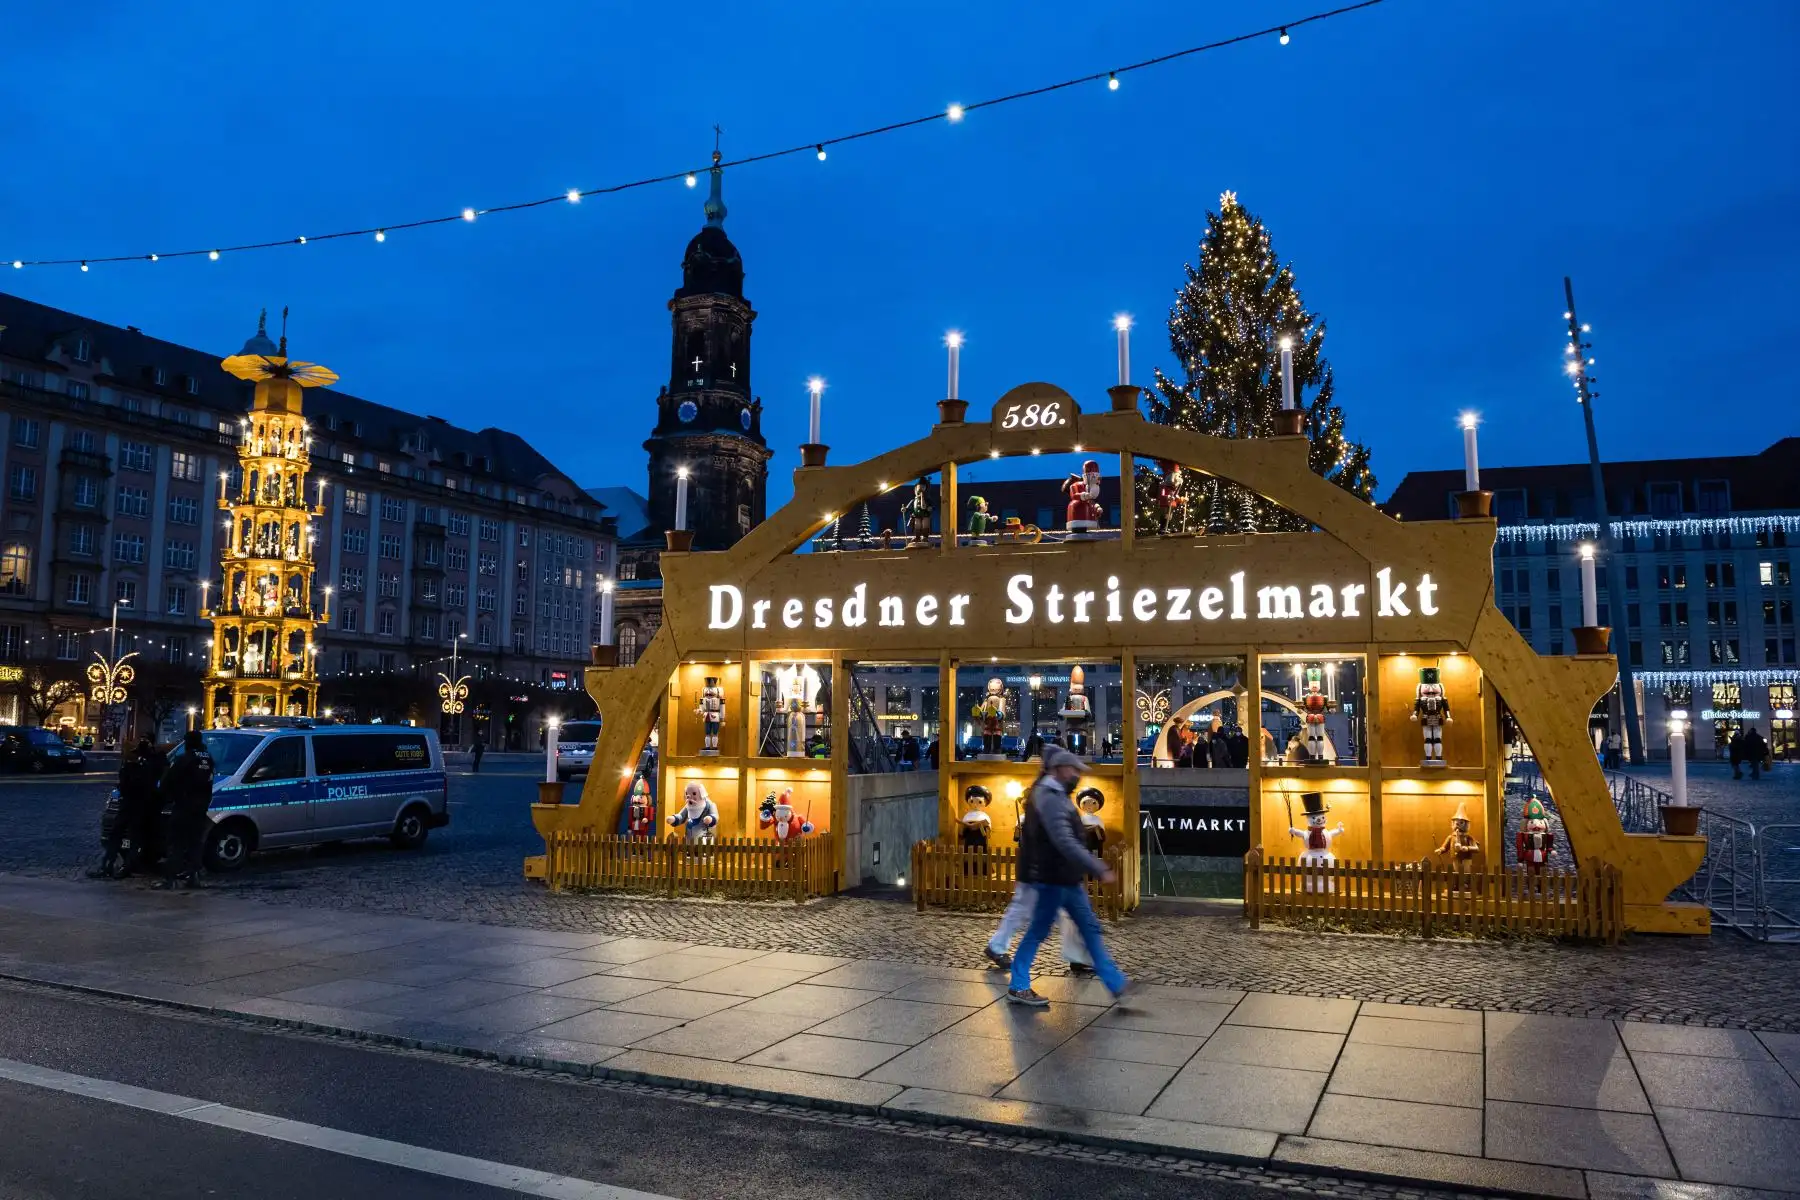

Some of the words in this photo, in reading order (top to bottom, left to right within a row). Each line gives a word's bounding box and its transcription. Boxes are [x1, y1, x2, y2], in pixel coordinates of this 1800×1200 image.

[1001, 402, 1066, 428] 586.
[708, 582, 970, 629] Dresdner
[1005, 567, 1439, 623] Striezelmarkt
[328, 785, 368, 798] POLIZEI
[1142, 817, 1246, 831] ALTMARKT
